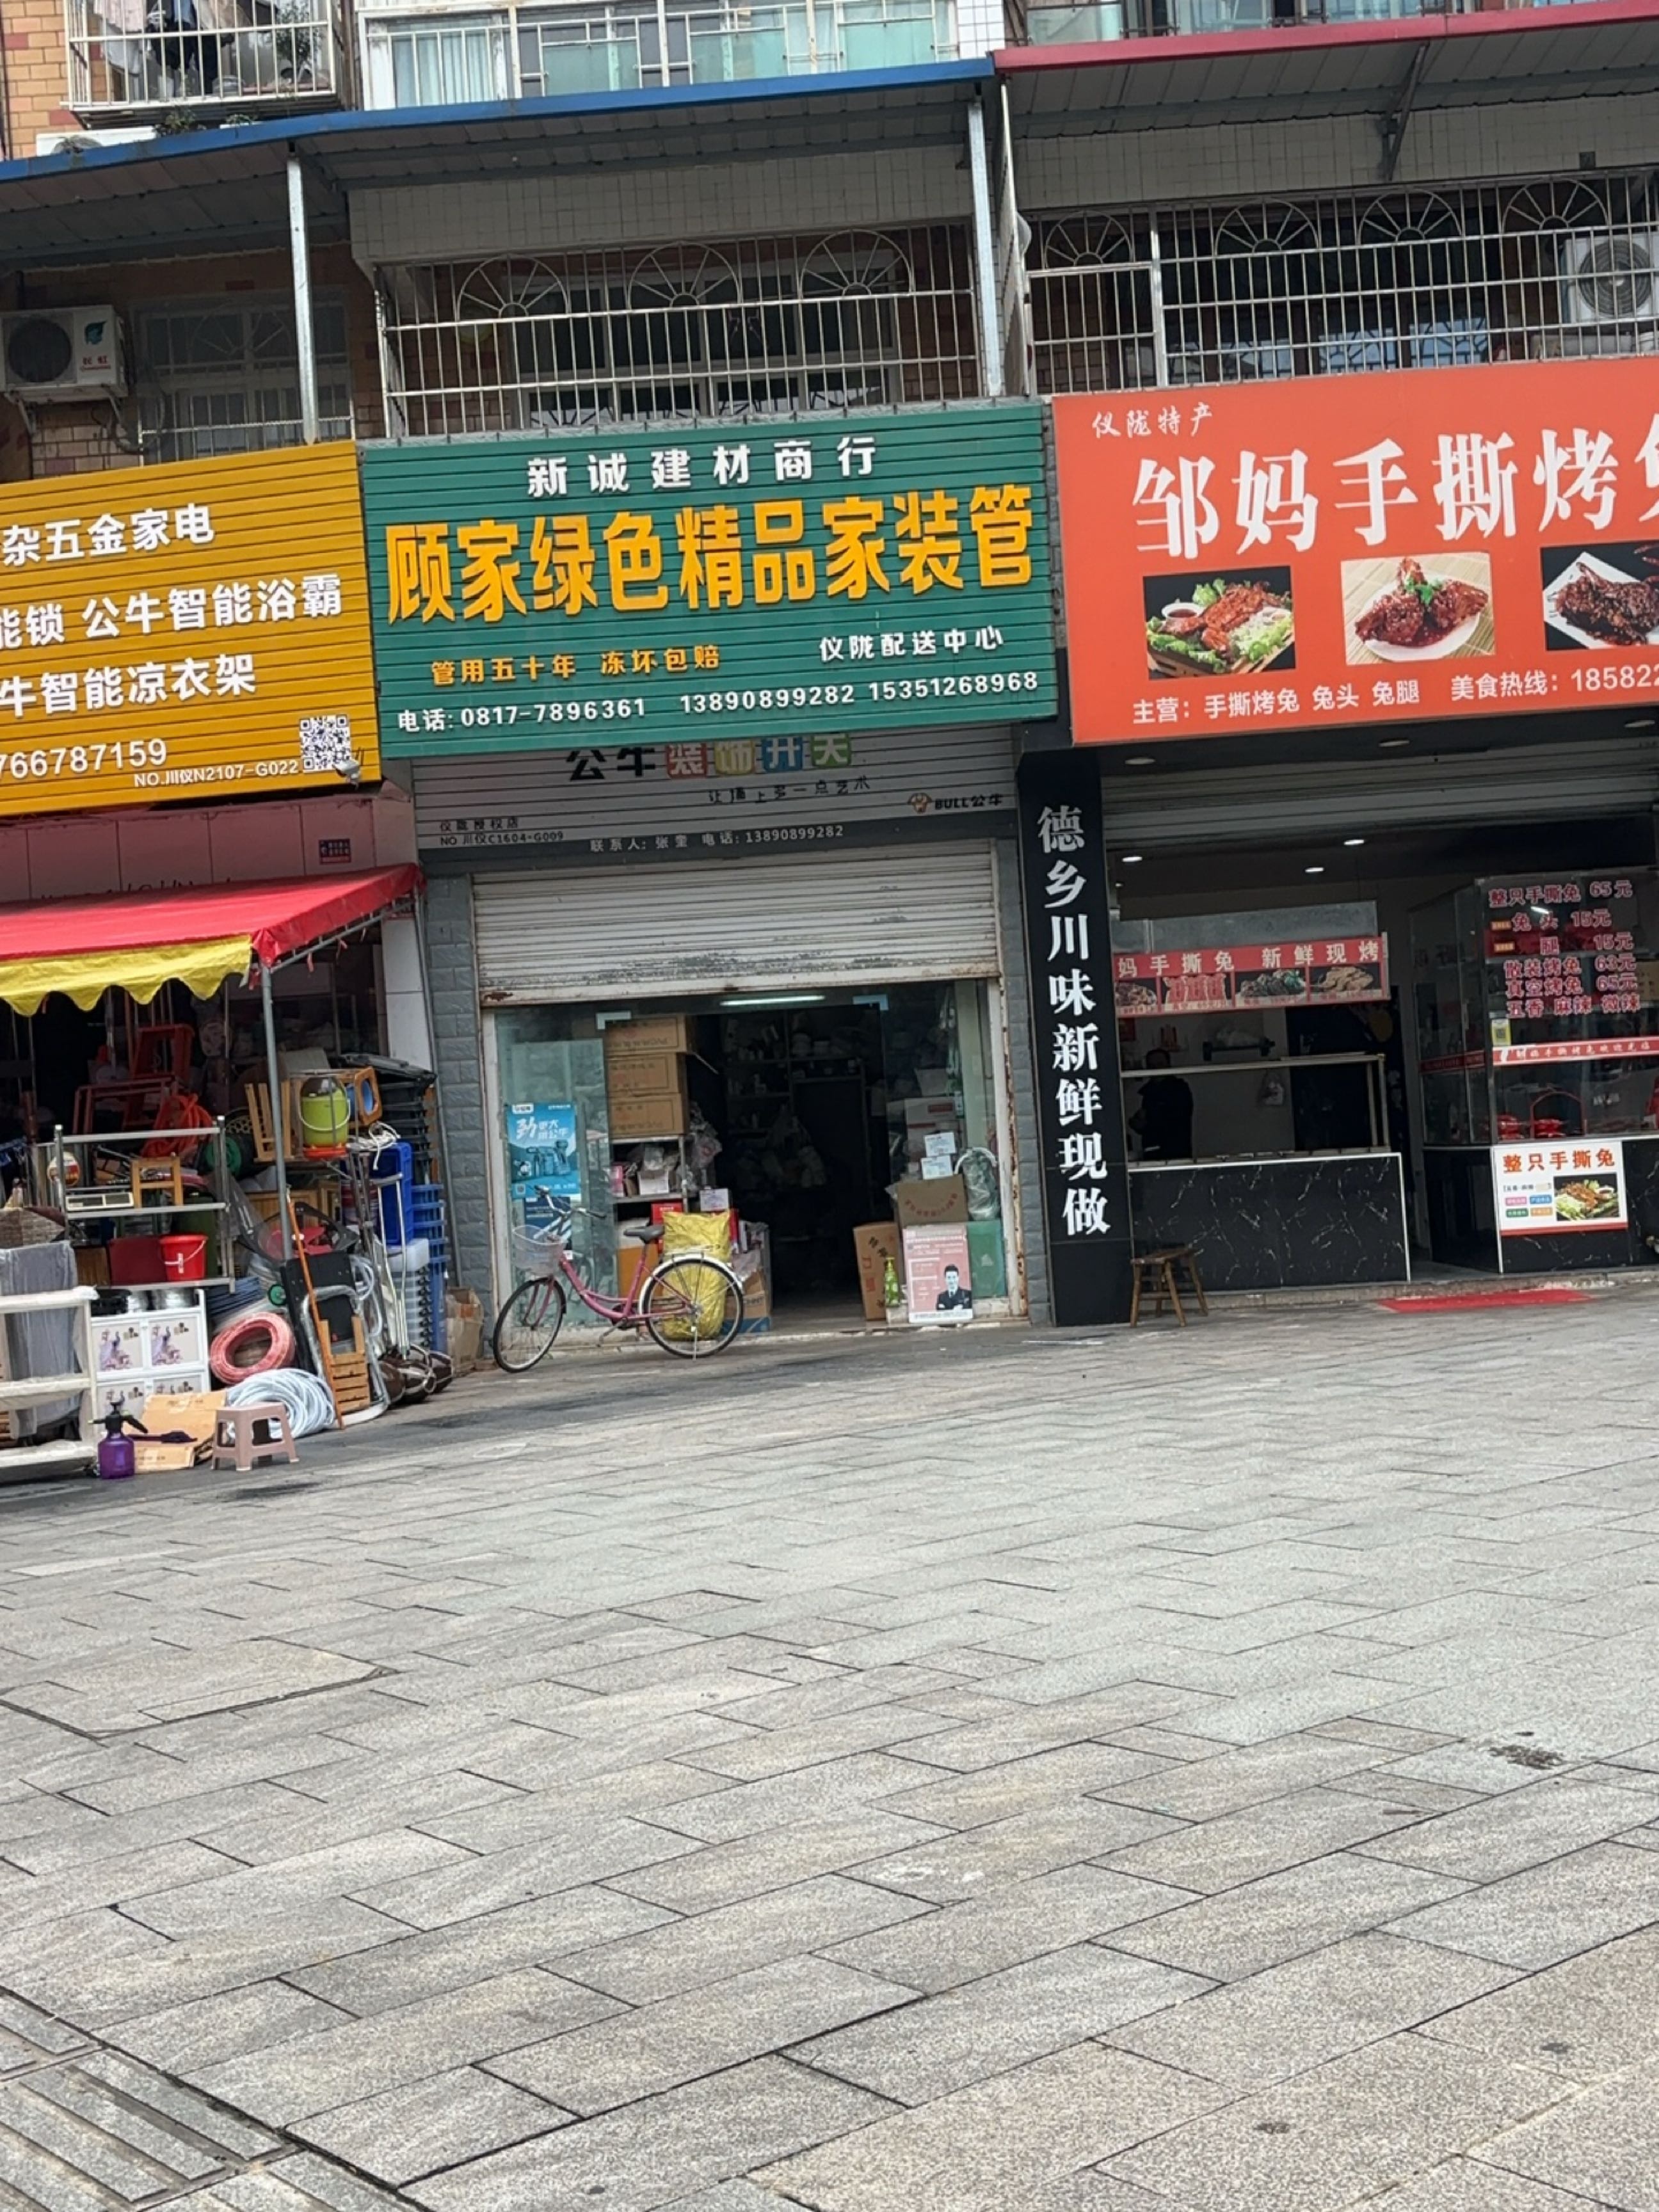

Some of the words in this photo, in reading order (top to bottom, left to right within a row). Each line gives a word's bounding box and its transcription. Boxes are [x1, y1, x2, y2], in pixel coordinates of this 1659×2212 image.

[1092, 401, 1212, 438] 仪陇特产
[527, 437, 876, 497] 新诚建材商行
[1132, 413, 1659, 560] 邹妈手撕烤
[2, 503, 215, 566] 杂五金家电
[387, 484, 1033, 625] 顾家绿色精品家装管
[82, 573, 342, 639] 公牛智能浴霸
[819, 625, 1004, 663] 仪陇配送中心
[0, 653, 256, 718] 牛智能凉衣架
[431, 654, 576, 687] 管用五十年
[600, 645, 720, 675] 冻坏包赔
[680, 685, 854, 714] 13890899282
[869, 672, 1038, 701] 15351268968
[1313, 683, 1359, 710] 兔头
[1372, 679, 1420, 707] 兔腿
[1571, 908, 1613, 928] 15元
[1118, 950, 1234, 979] 妈手撕兔
[1262, 939, 1379, 968] 新鲜现烤
[1593, 931, 1634, 951] 15元
[1038, 804, 1112, 1237] 德乡川味新鲜现做
[1502, 1148, 1615, 1174] 整只手撕兔
